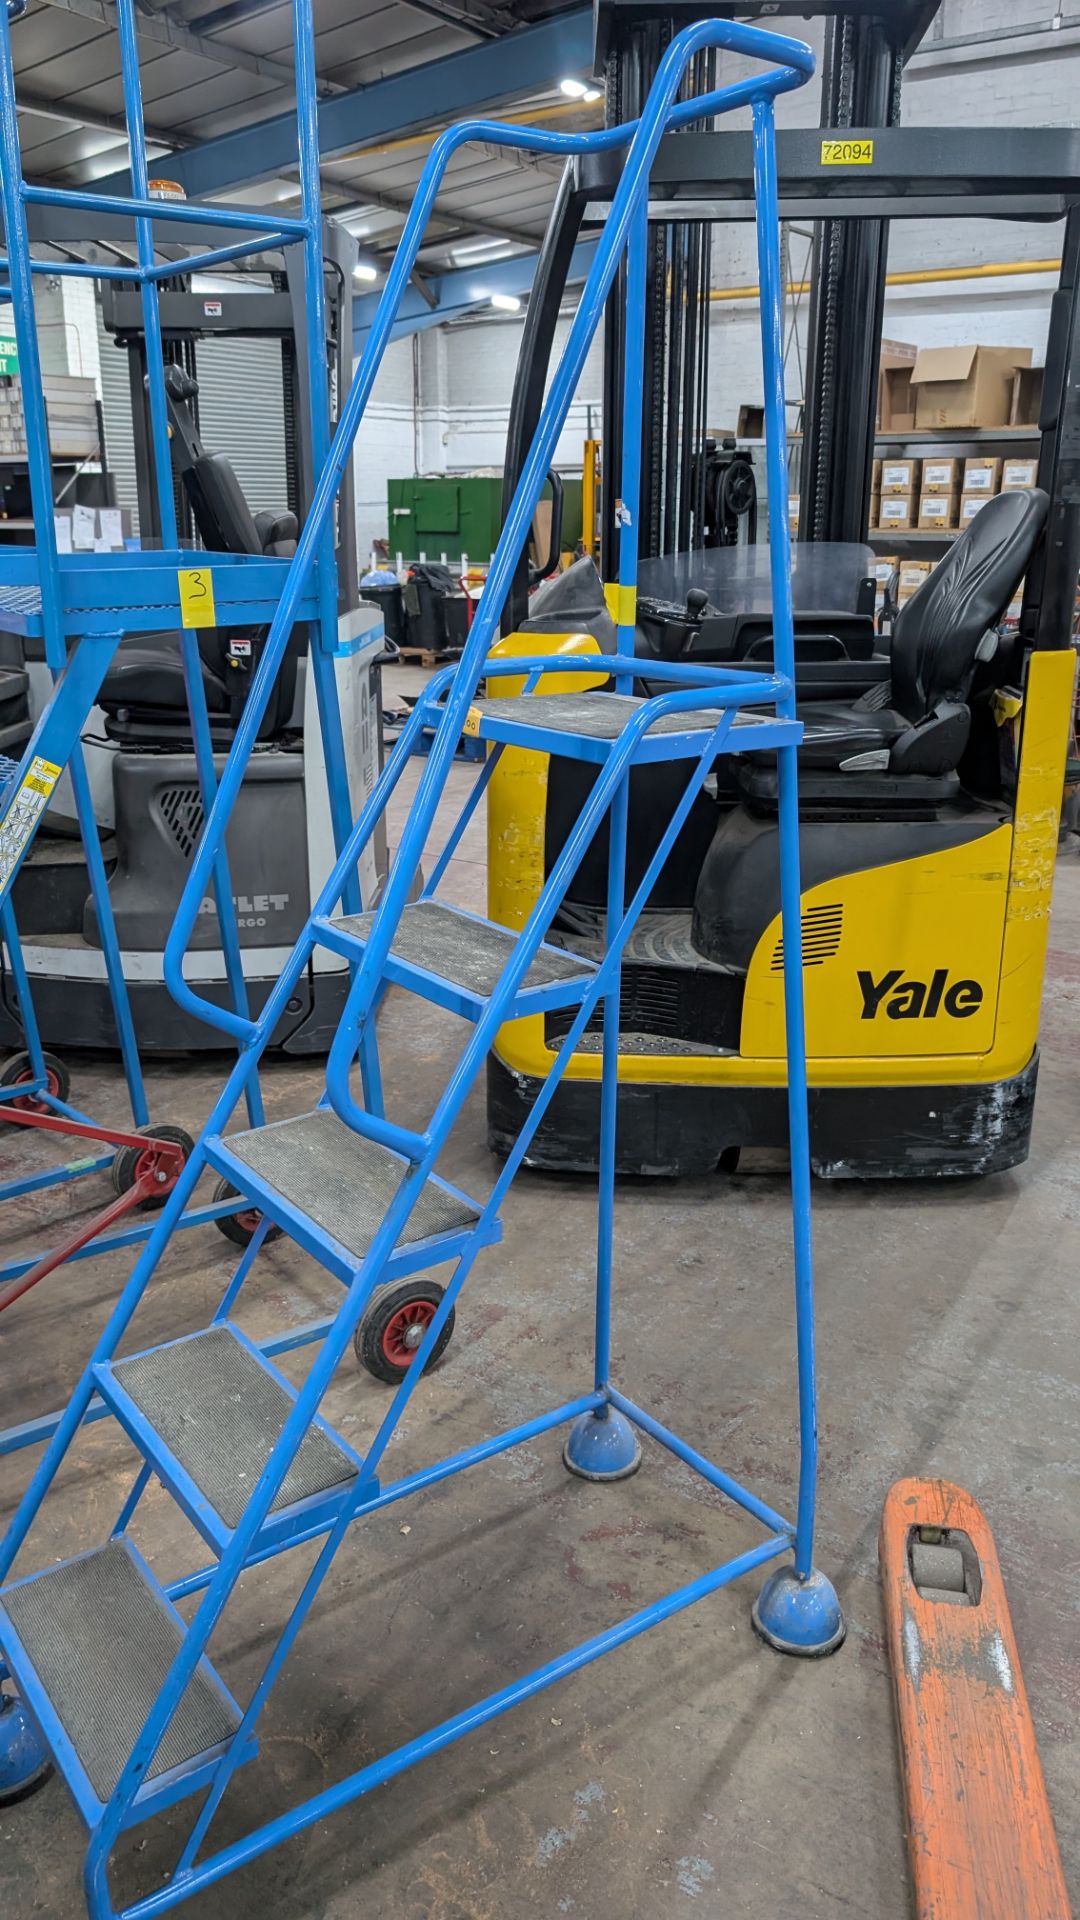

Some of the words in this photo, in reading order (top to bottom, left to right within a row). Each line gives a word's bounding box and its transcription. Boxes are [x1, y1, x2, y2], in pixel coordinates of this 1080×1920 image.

[823, 144, 872, 160] 72094
[188, 571, 207, 599] 3
[198, 893, 289, 914] ALET
[237, 917, 266, 928] RGO
[856, 969, 984, 1019] Yale
